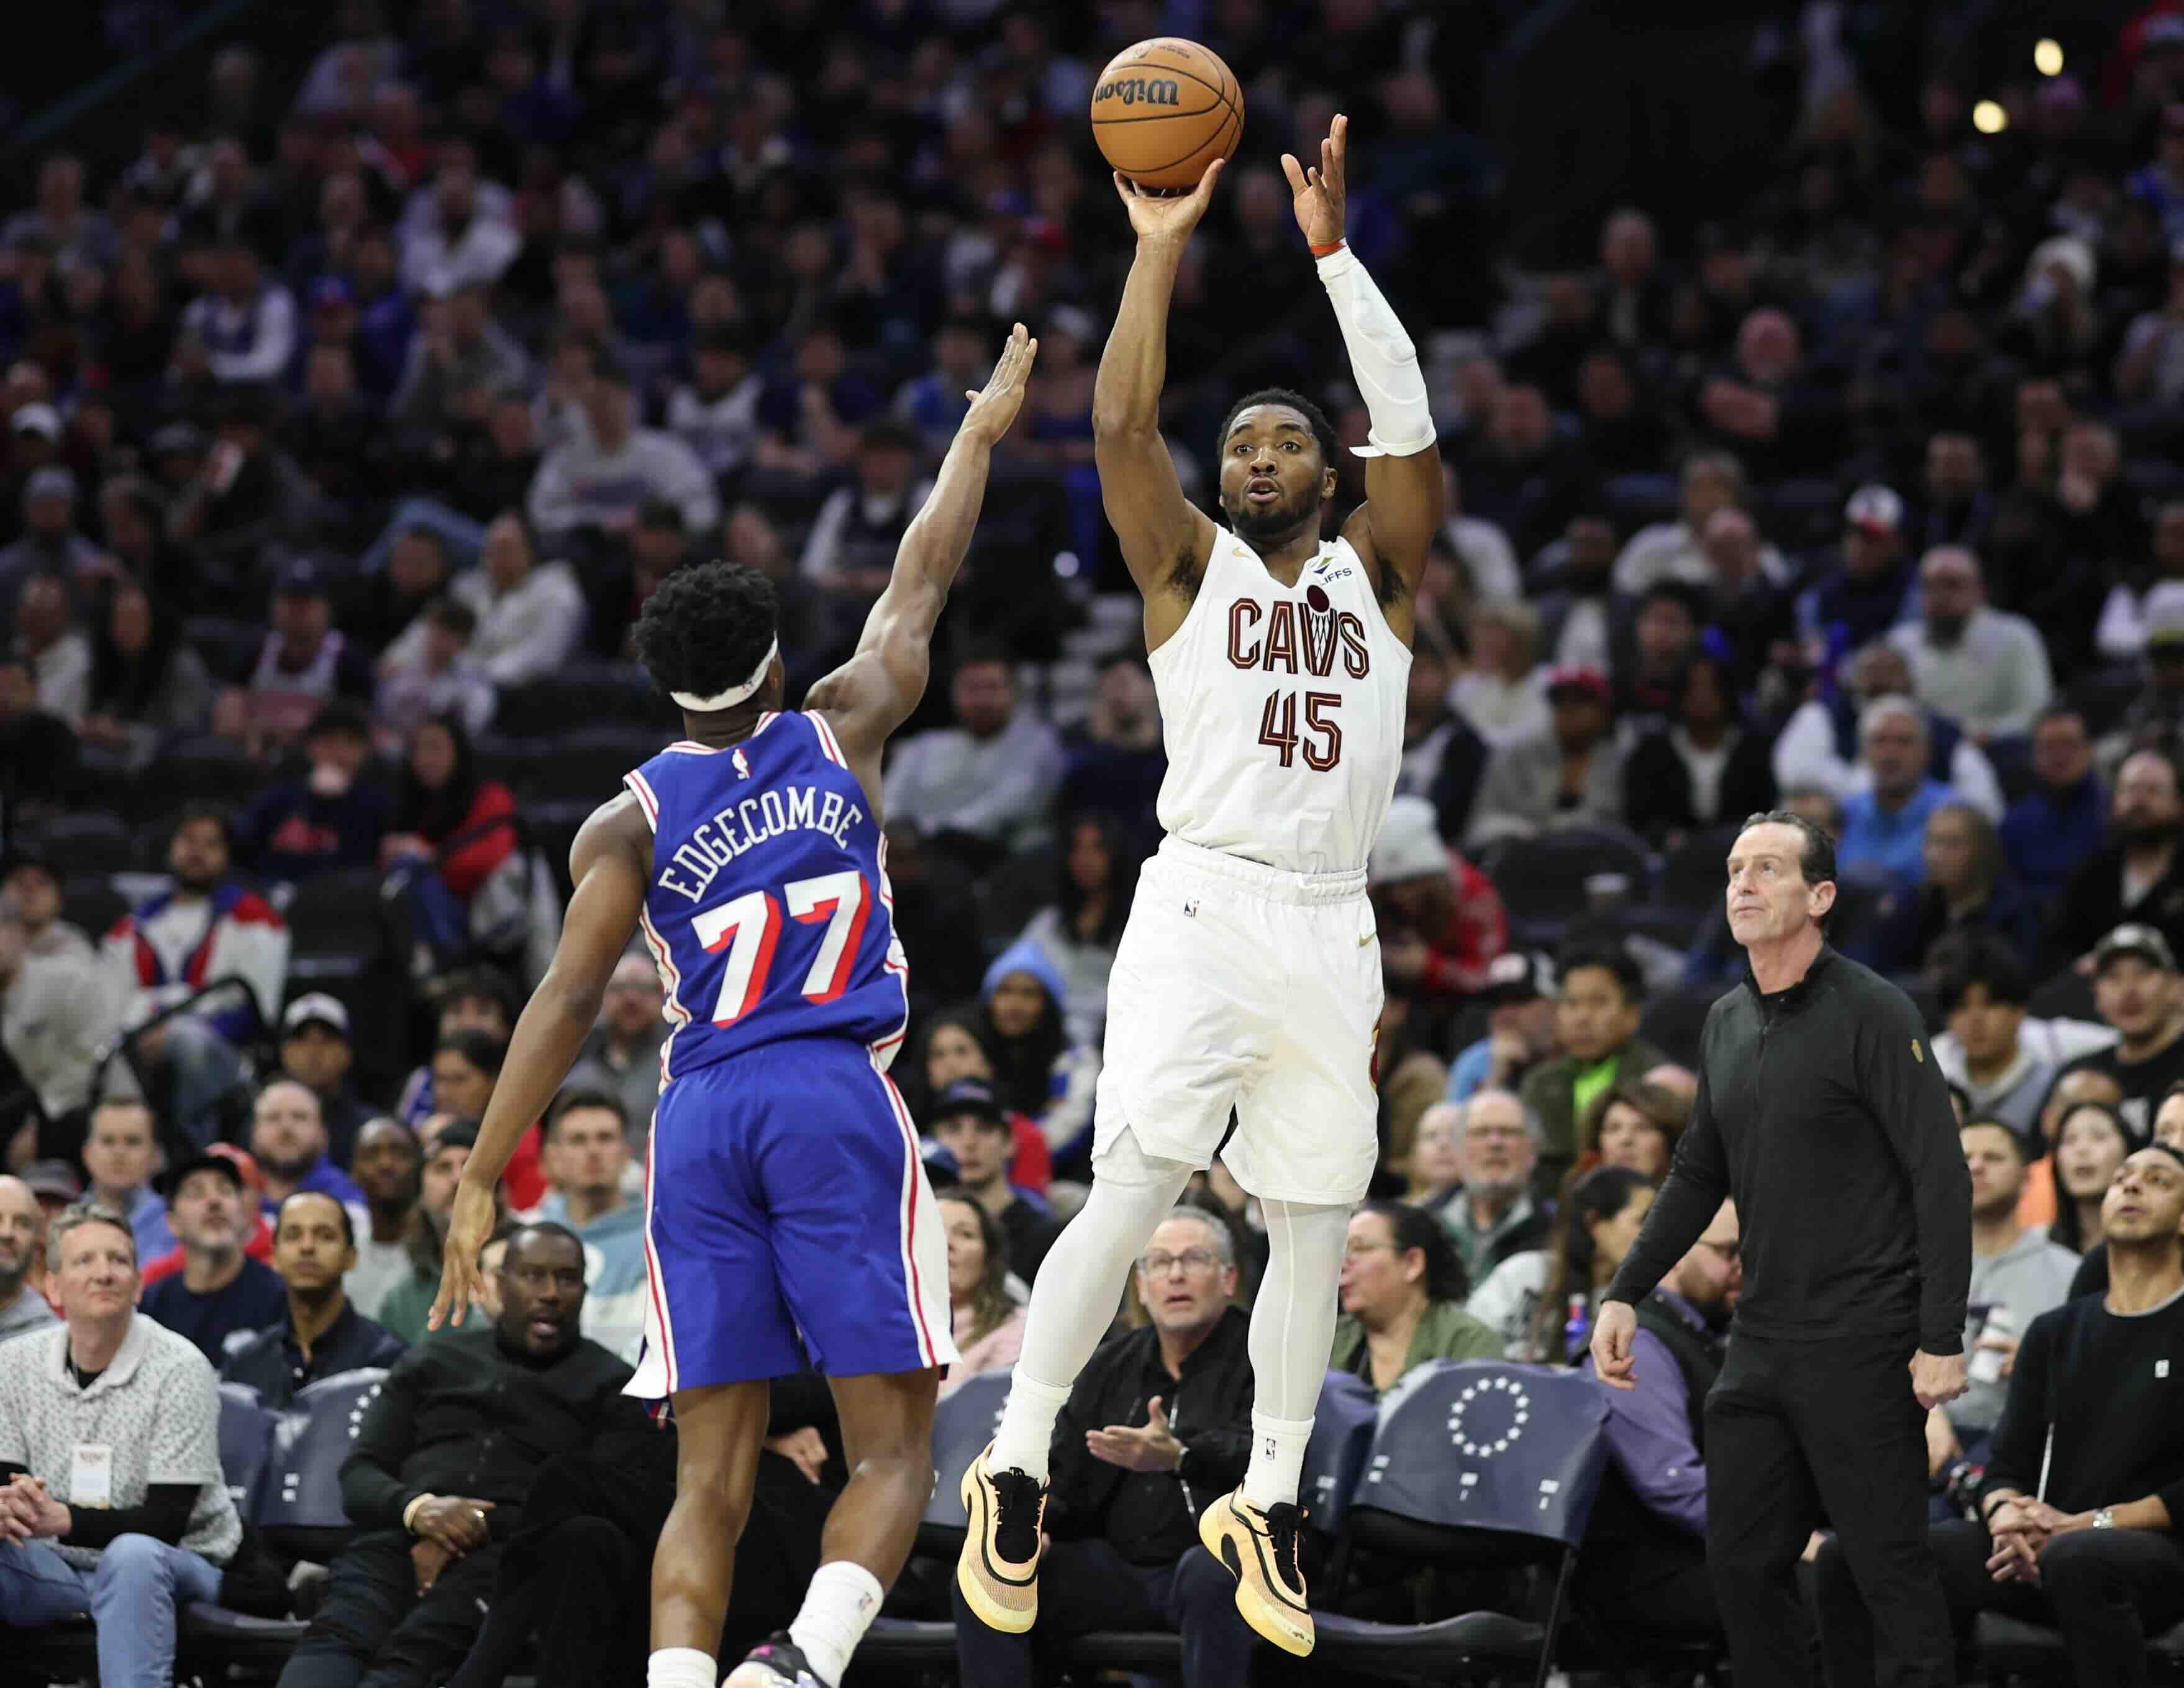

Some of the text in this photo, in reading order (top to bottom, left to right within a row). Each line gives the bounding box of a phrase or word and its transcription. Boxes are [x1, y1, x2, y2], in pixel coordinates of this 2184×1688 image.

[1095, 78, 1180, 107] Wilson
[1227, 585, 1370, 680] CAVS
[1258, 688, 1343, 773] 45
[658, 786, 863, 904] EDGECOMBE
[691, 870, 871, 1028] 77
